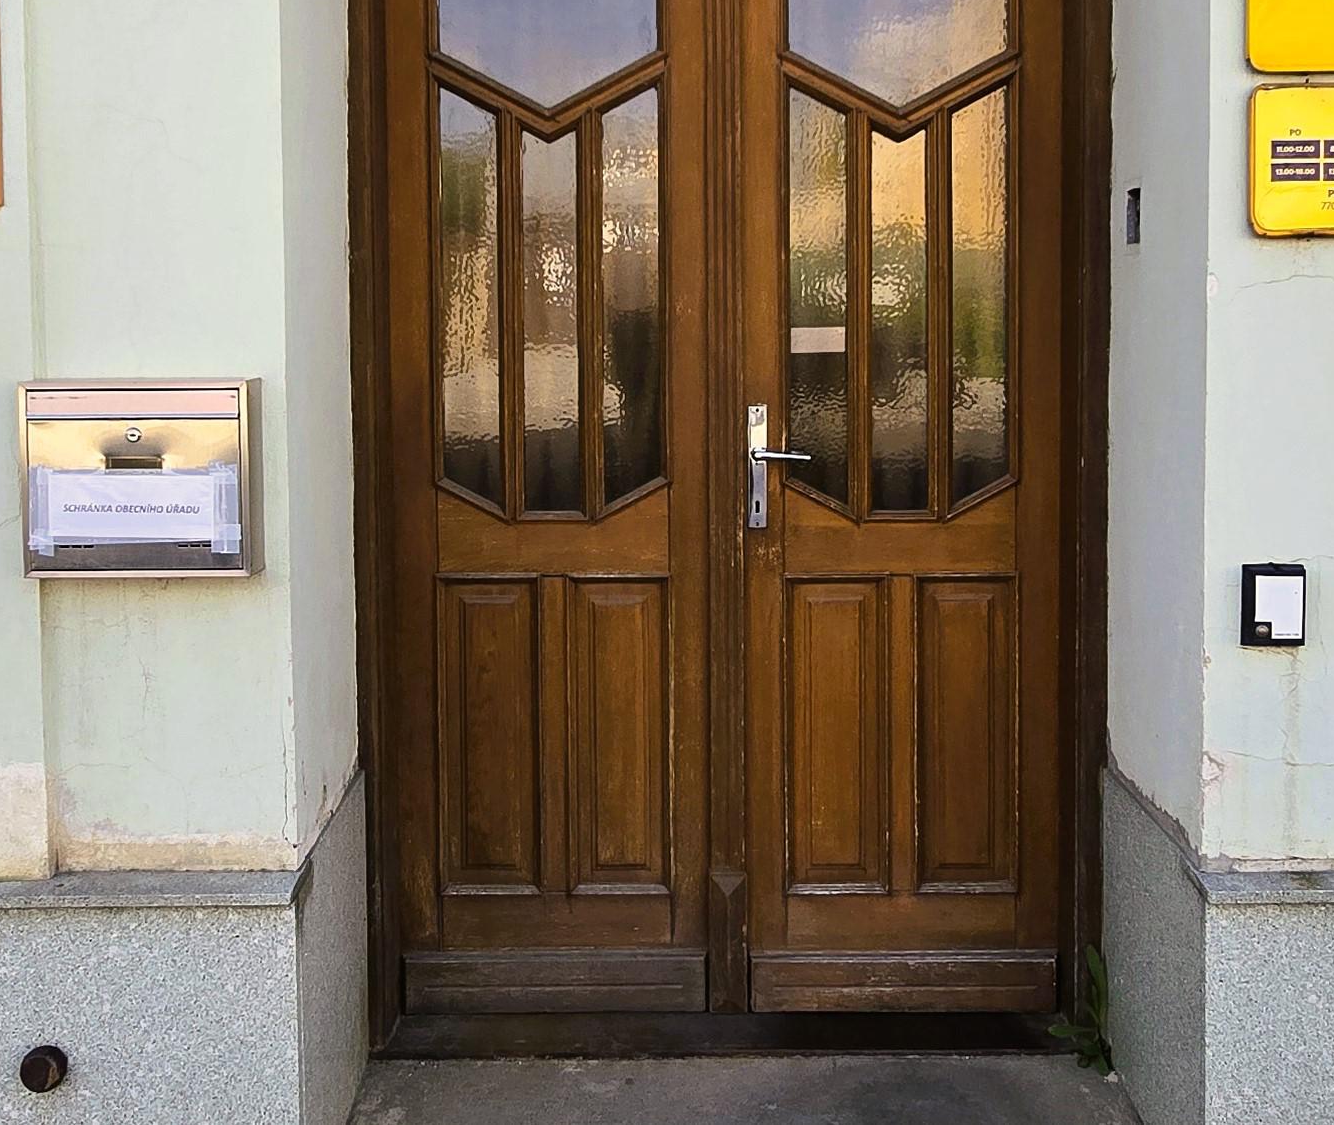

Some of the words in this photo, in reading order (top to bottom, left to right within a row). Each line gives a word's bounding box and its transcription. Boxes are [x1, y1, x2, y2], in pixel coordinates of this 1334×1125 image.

[63, 502, 113, 513] SCHRÁNKA
[115, 503, 164, 514] OBECNÍHO
[165, 503, 200, 515] ÚŘADU
